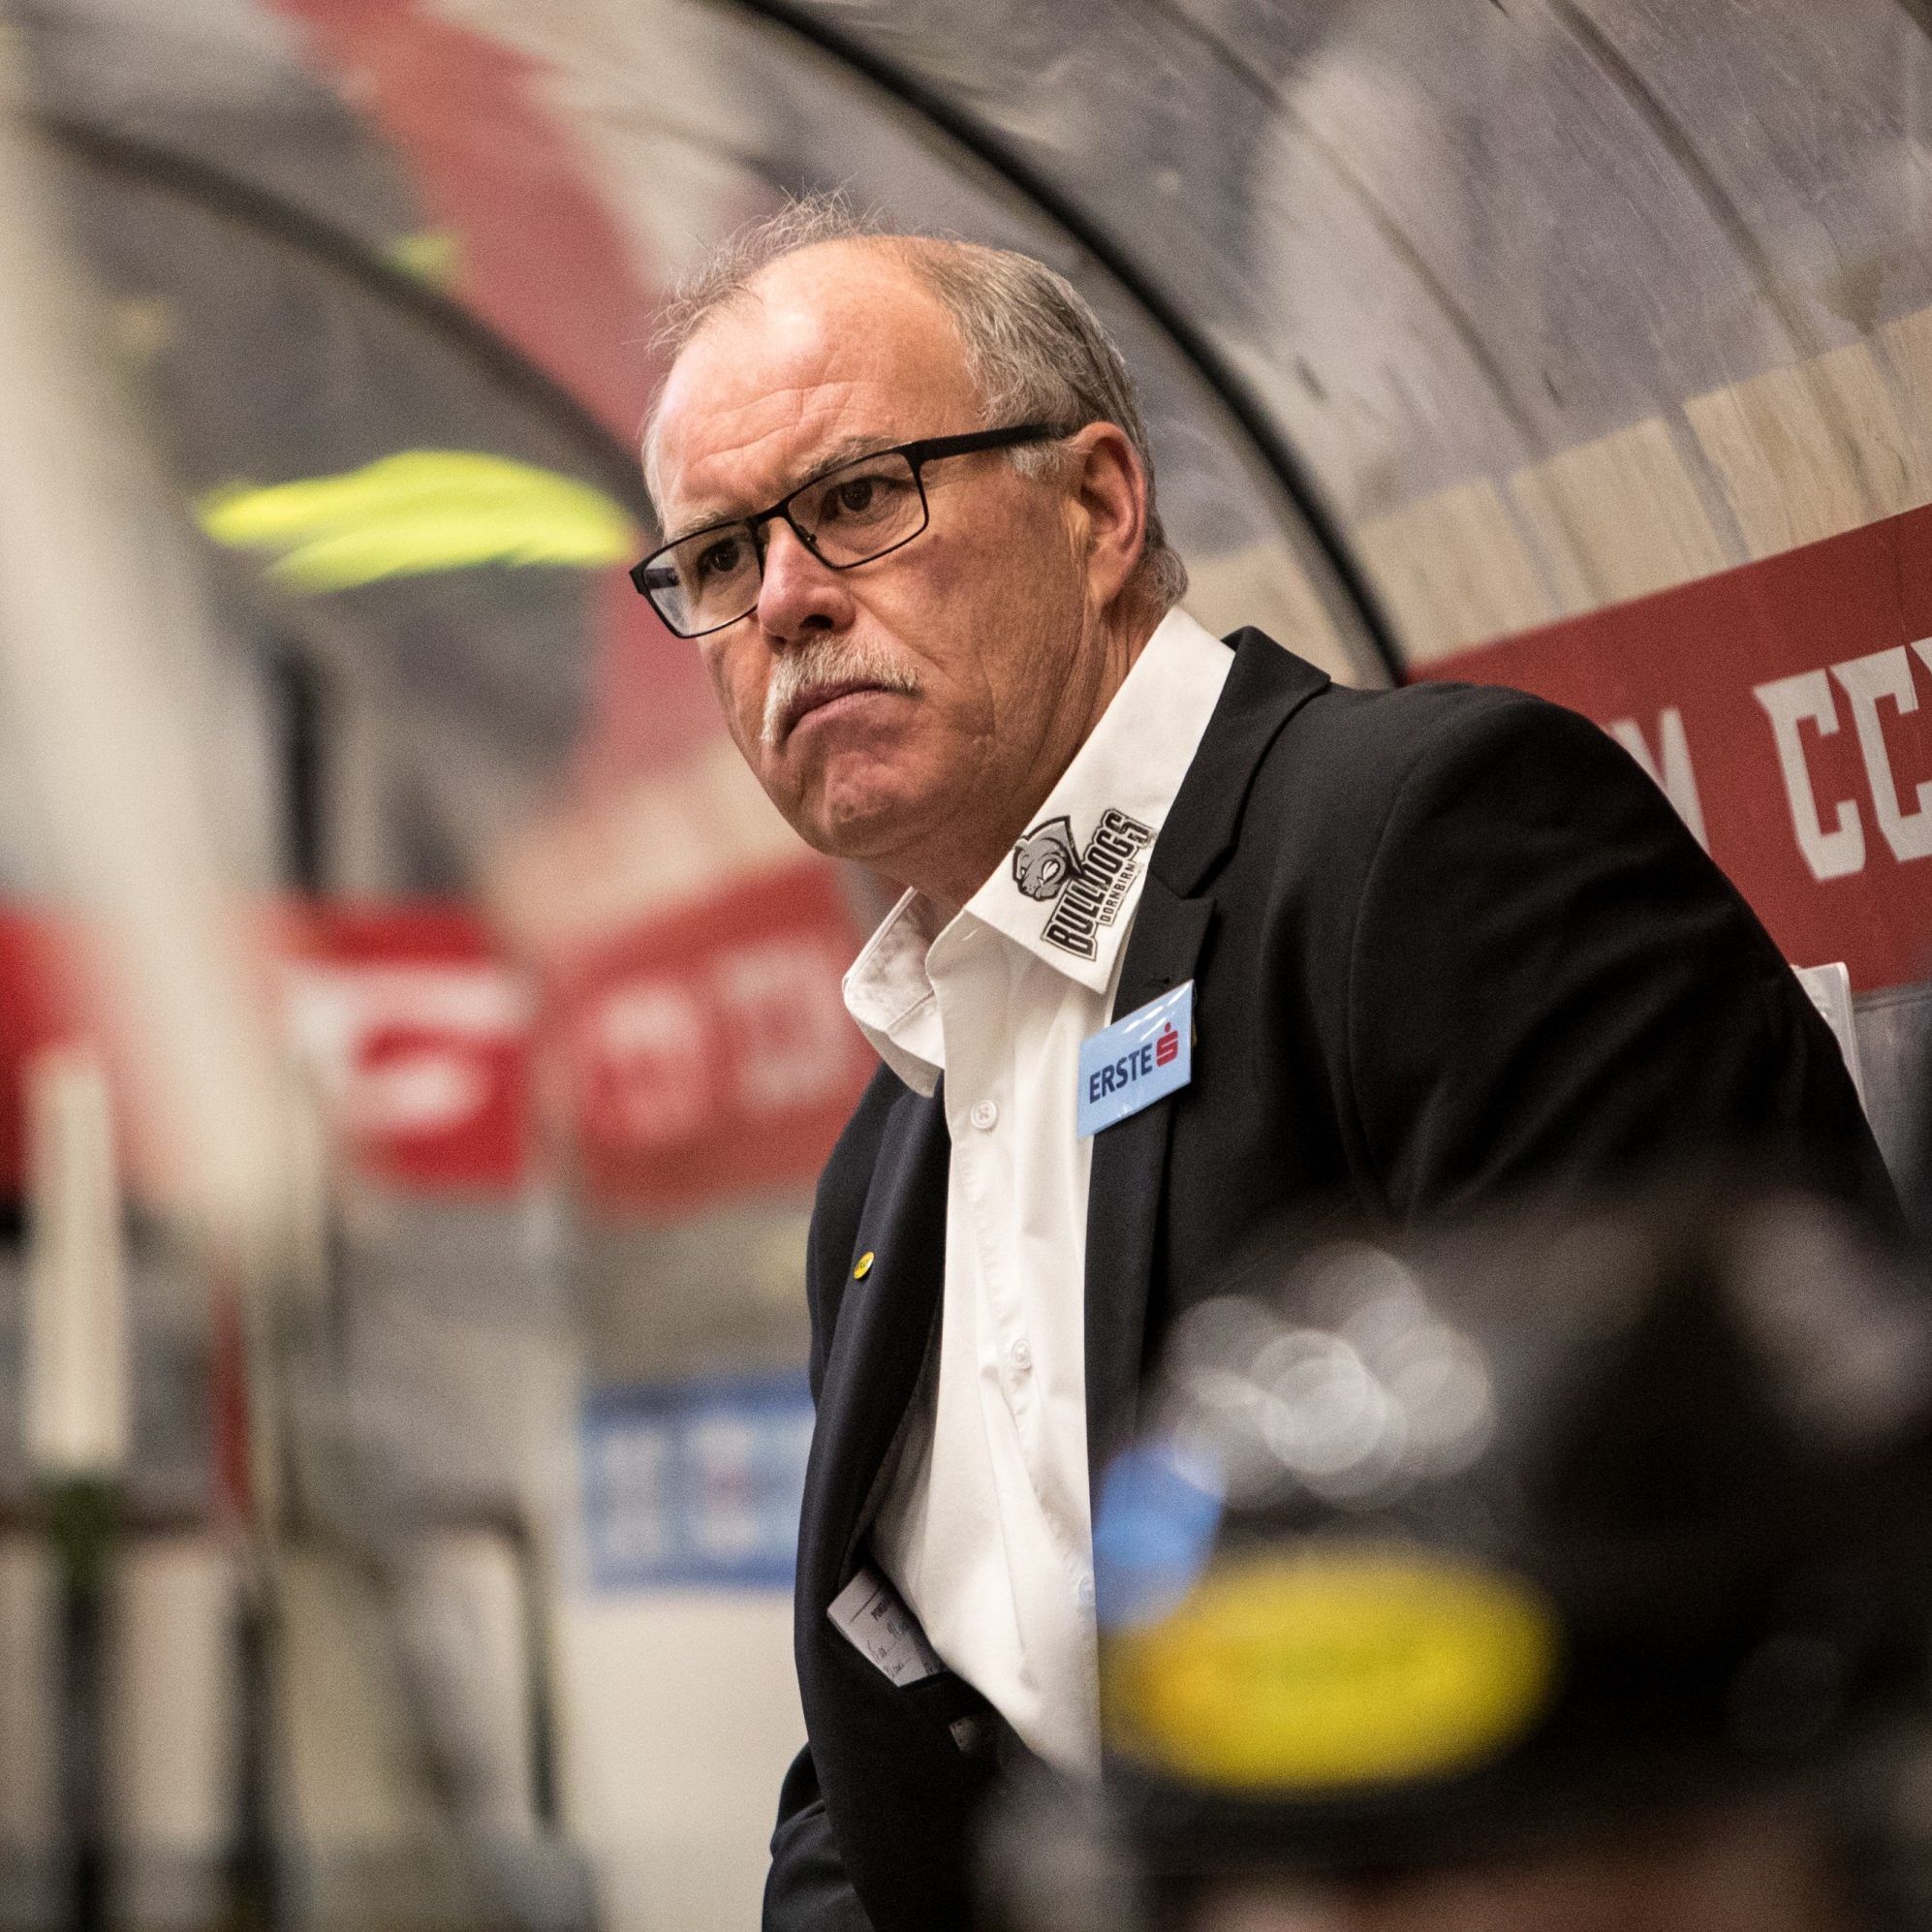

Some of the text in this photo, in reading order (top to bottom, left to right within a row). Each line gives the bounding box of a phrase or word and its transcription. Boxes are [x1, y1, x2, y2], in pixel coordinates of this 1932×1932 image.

[1753, 637, 1932, 883] CC
[1044, 810, 1152, 957] BULLDOGS
[1099, 860, 1138, 922] DORNBIRN
[1089, 1043, 1153, 1105] ERSTE
